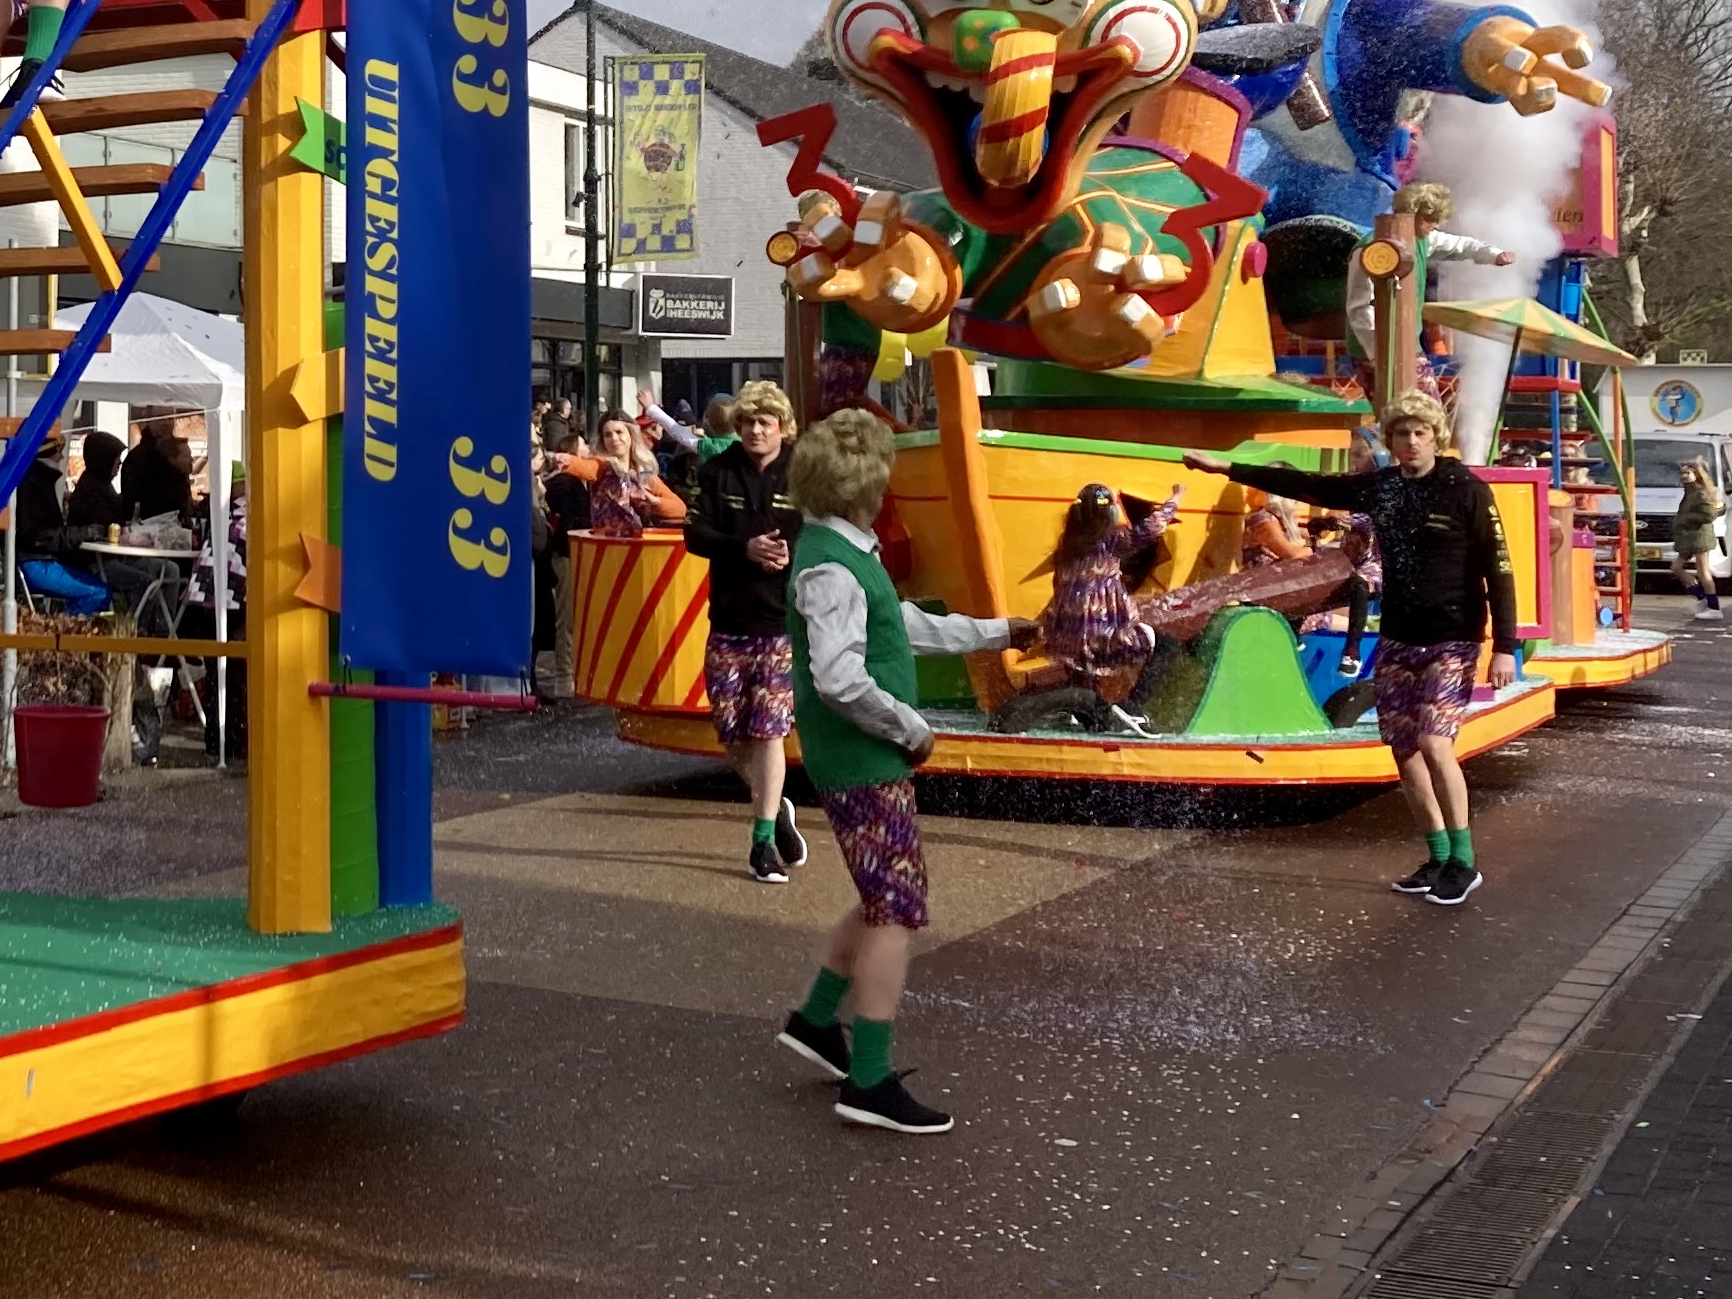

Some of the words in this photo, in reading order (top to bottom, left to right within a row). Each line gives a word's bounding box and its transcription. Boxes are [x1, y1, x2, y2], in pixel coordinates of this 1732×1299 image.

[364, 58, 400, 482] UITGESPEELD
[666, 300, 725, 310] BAKKERIJ
[670, 309, 724, 319] HEESWIJK
[447, 435, 511, 579] 33
